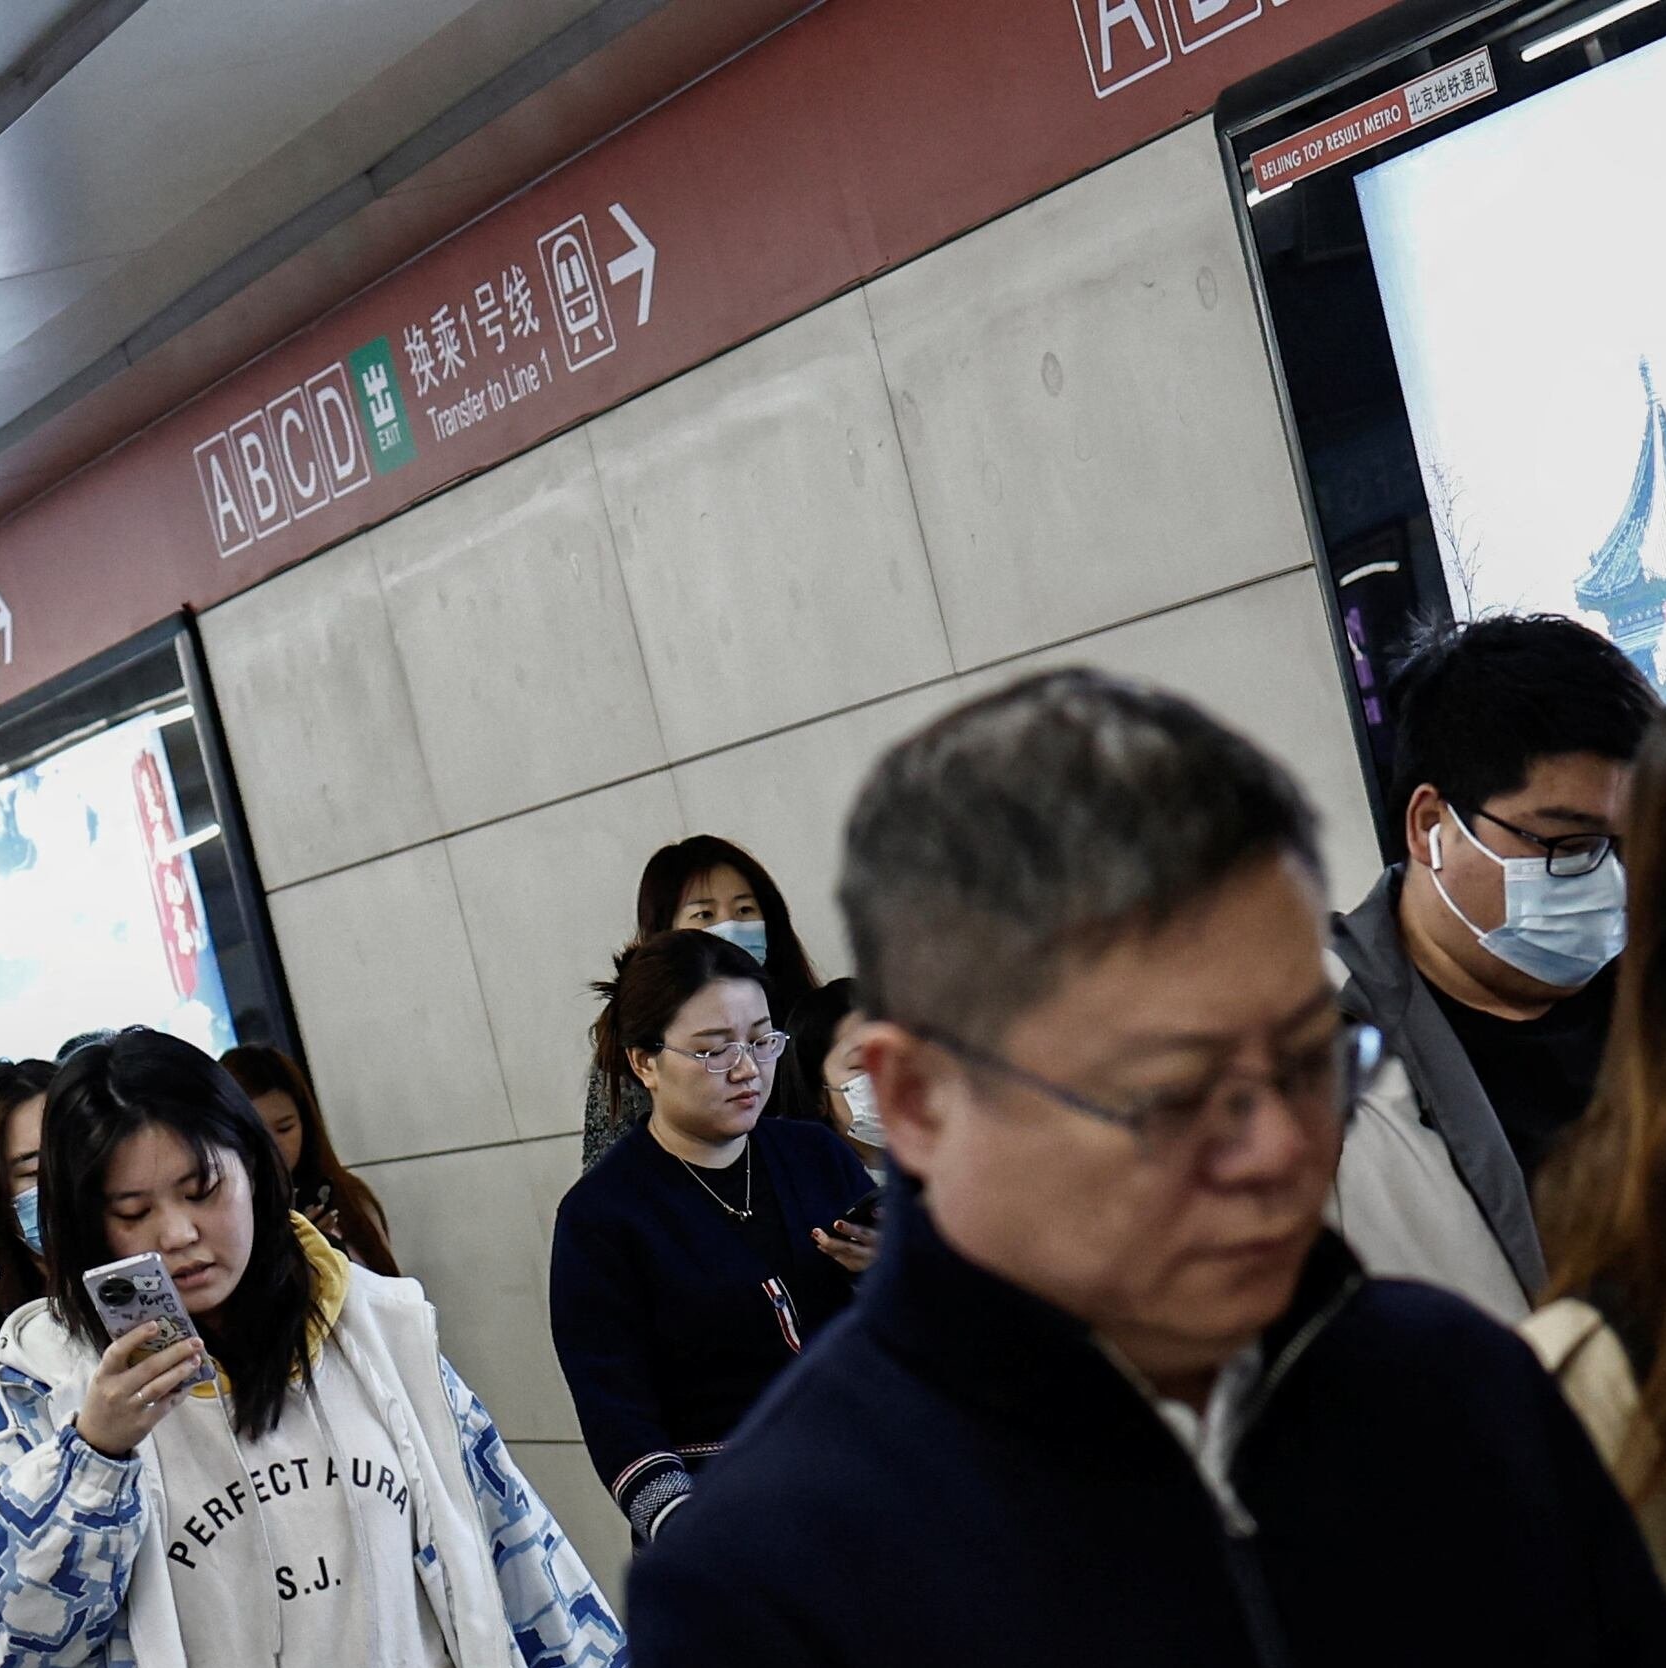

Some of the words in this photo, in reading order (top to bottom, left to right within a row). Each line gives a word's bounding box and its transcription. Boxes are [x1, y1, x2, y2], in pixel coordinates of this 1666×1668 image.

[1409, 60, 1490, 117] 北京地铁通成
[1260, 150, 1301, 181] BEIJING
[1302, 140, 1324, 163] TOP
[1325, 121, 1362, 152] RESULT
[1363, 104, 1402, 136] METRO
[404, 264, 539, 397] 换乘1号线
[426, 388, 488, 442] Transfer
[486, 379, 506, 412] to
[503, 363, 541, 402] Line
[540, 347, 553, 383] 1
[378, 424, 402, 452] EXIT
[167, 1457, 310, 1570] PERFECT
[275, 1556, 342, 1601] S.J.
